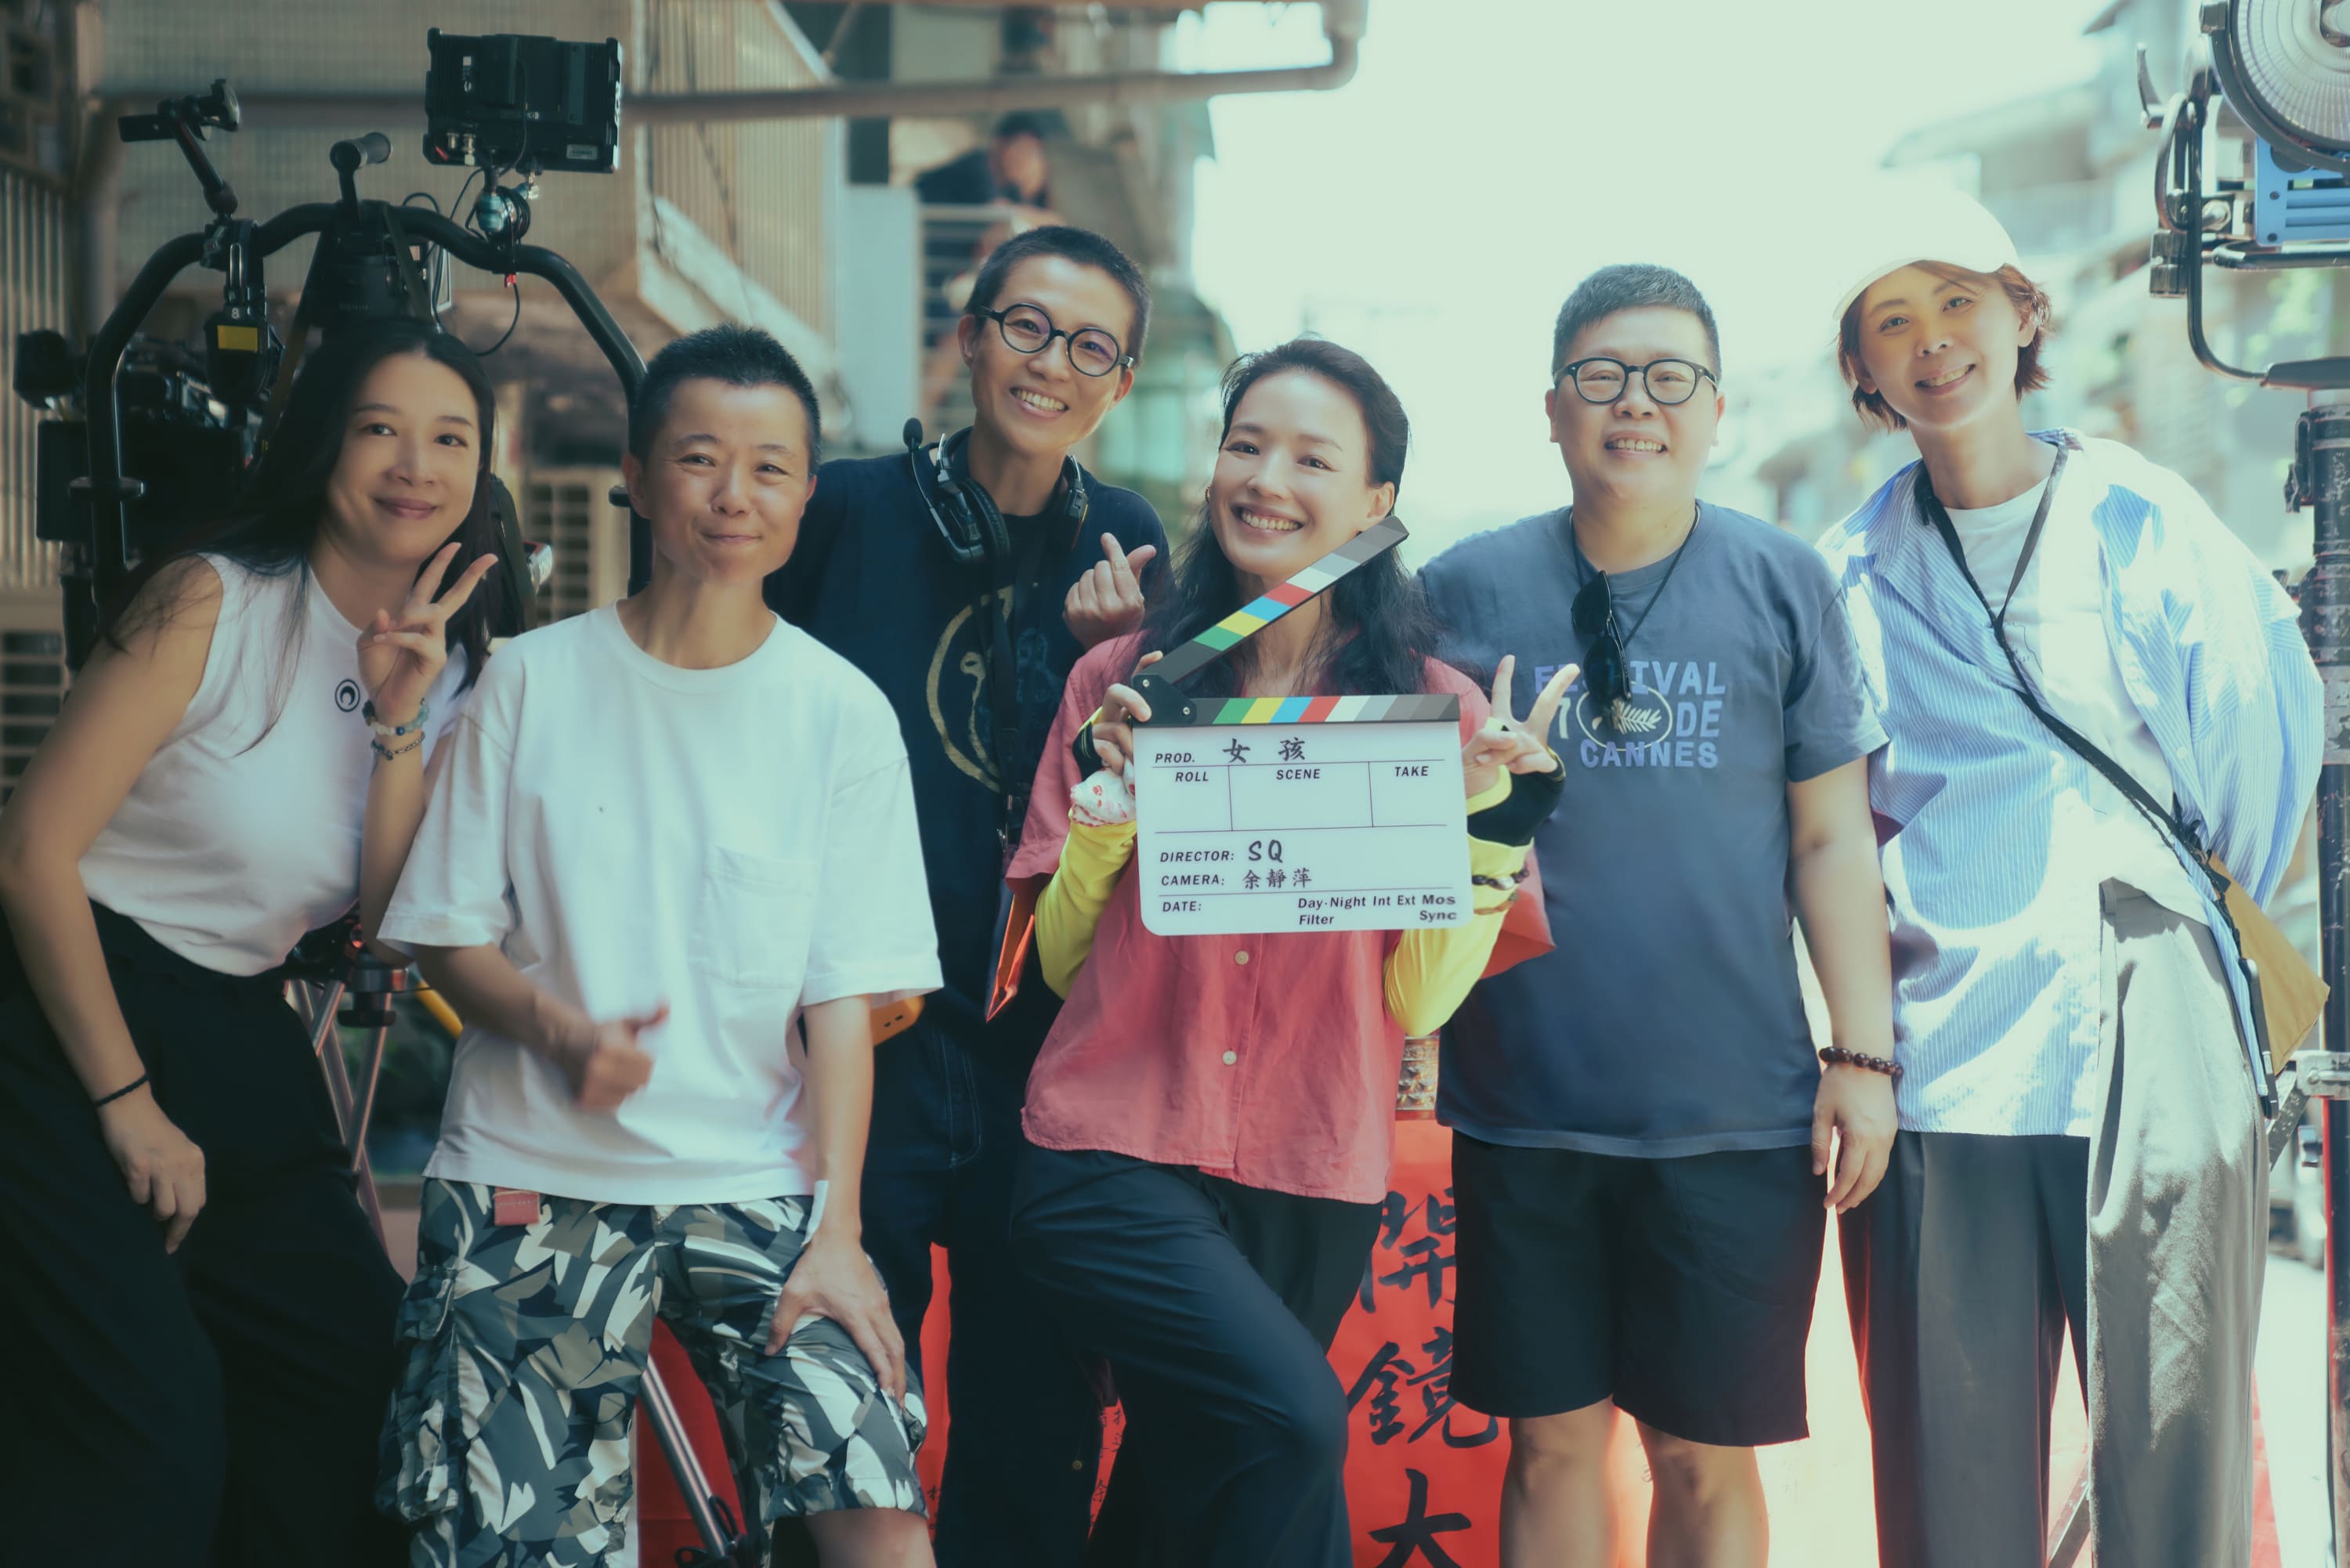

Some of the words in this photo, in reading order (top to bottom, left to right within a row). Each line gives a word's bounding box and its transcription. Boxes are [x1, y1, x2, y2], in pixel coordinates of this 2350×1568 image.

[1676, 700, 1723, 738] DE
[1155, 753, 1195, 764] PROD.
[1579, 739, 1719, 769] CANNES
[1175, 771, 1209, 782] ROLL
[1276, 768, 1321, 780] SCENE
[1395, 766, 1430, 777] TAKE
[1160, 851, 1235, 862] DIRECTOR:
[1161, 875, 1225, 886] CAMERA:
[1242, 867, 1312, 890] 余靜萍
[1373, 895, 1390, 906] Int
[1397, 894, 1415, 906] Ext
[1422, 894, 1456, 905] Mos
[1162, 901, 1202, 912] DATE:
[1299, 915, 1334, 926] Filter
[1419, 909, 1457, 923] Sync
